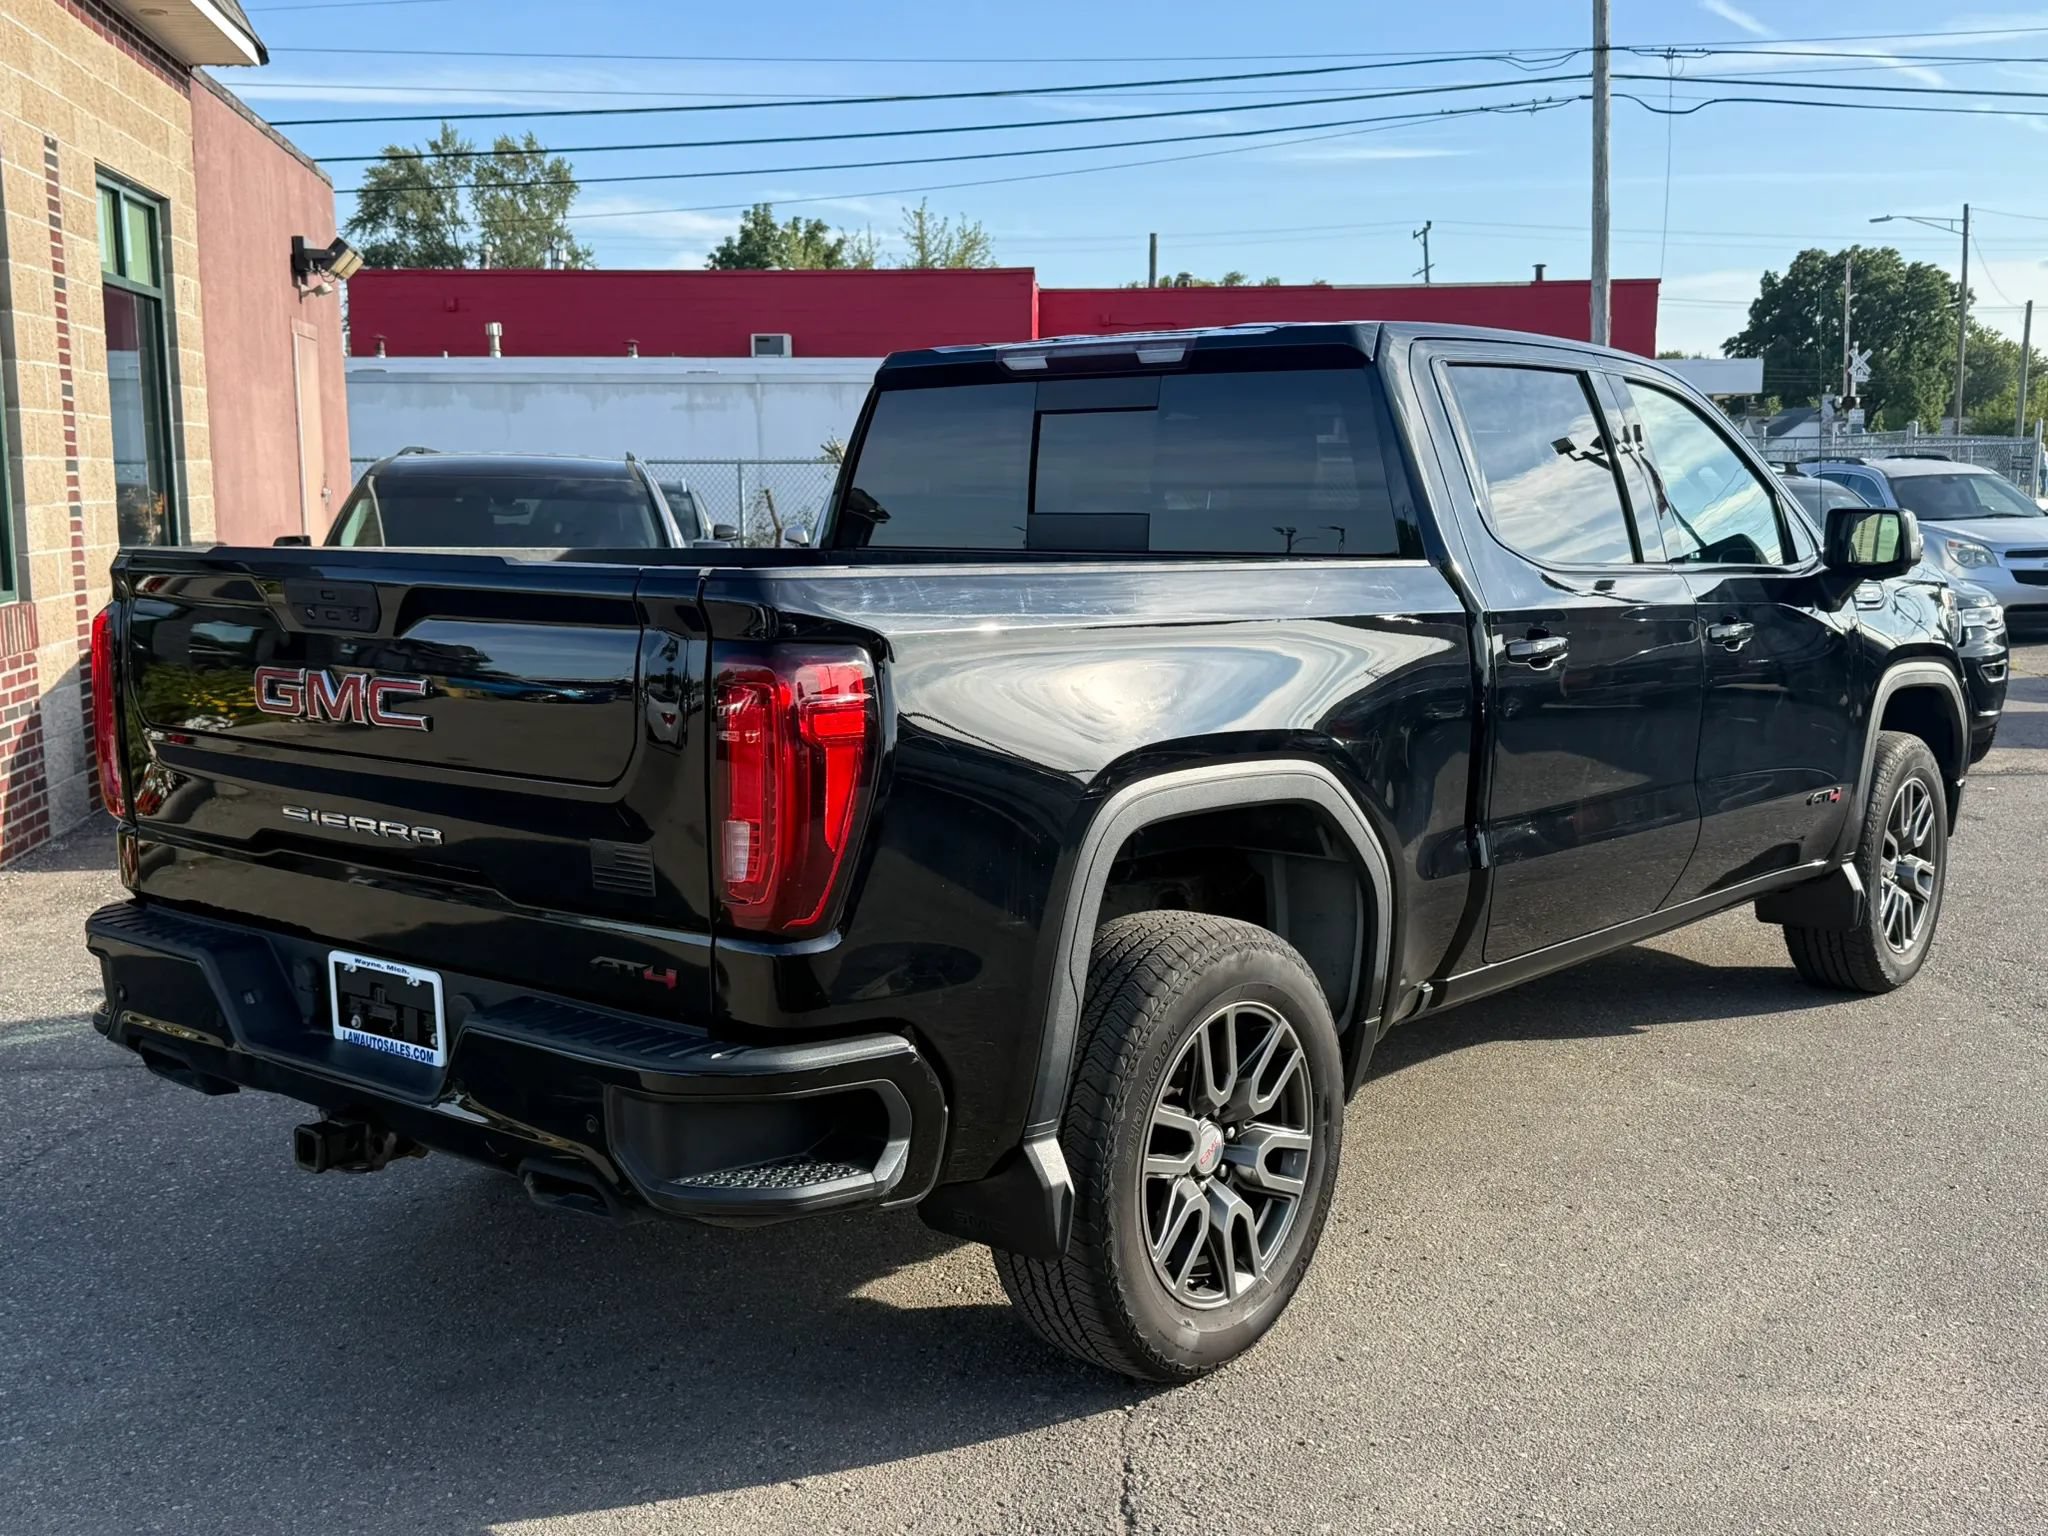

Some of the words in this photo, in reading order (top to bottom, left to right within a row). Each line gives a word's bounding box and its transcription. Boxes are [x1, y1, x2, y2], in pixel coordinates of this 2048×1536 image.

[254, 665, 434, 732] GMC
[282, 805, 445, 846] SIERRA
[589, 955, 677, 990] AT4
[342, 1029, 434, 1063] LAWAUTOSALES.COM
